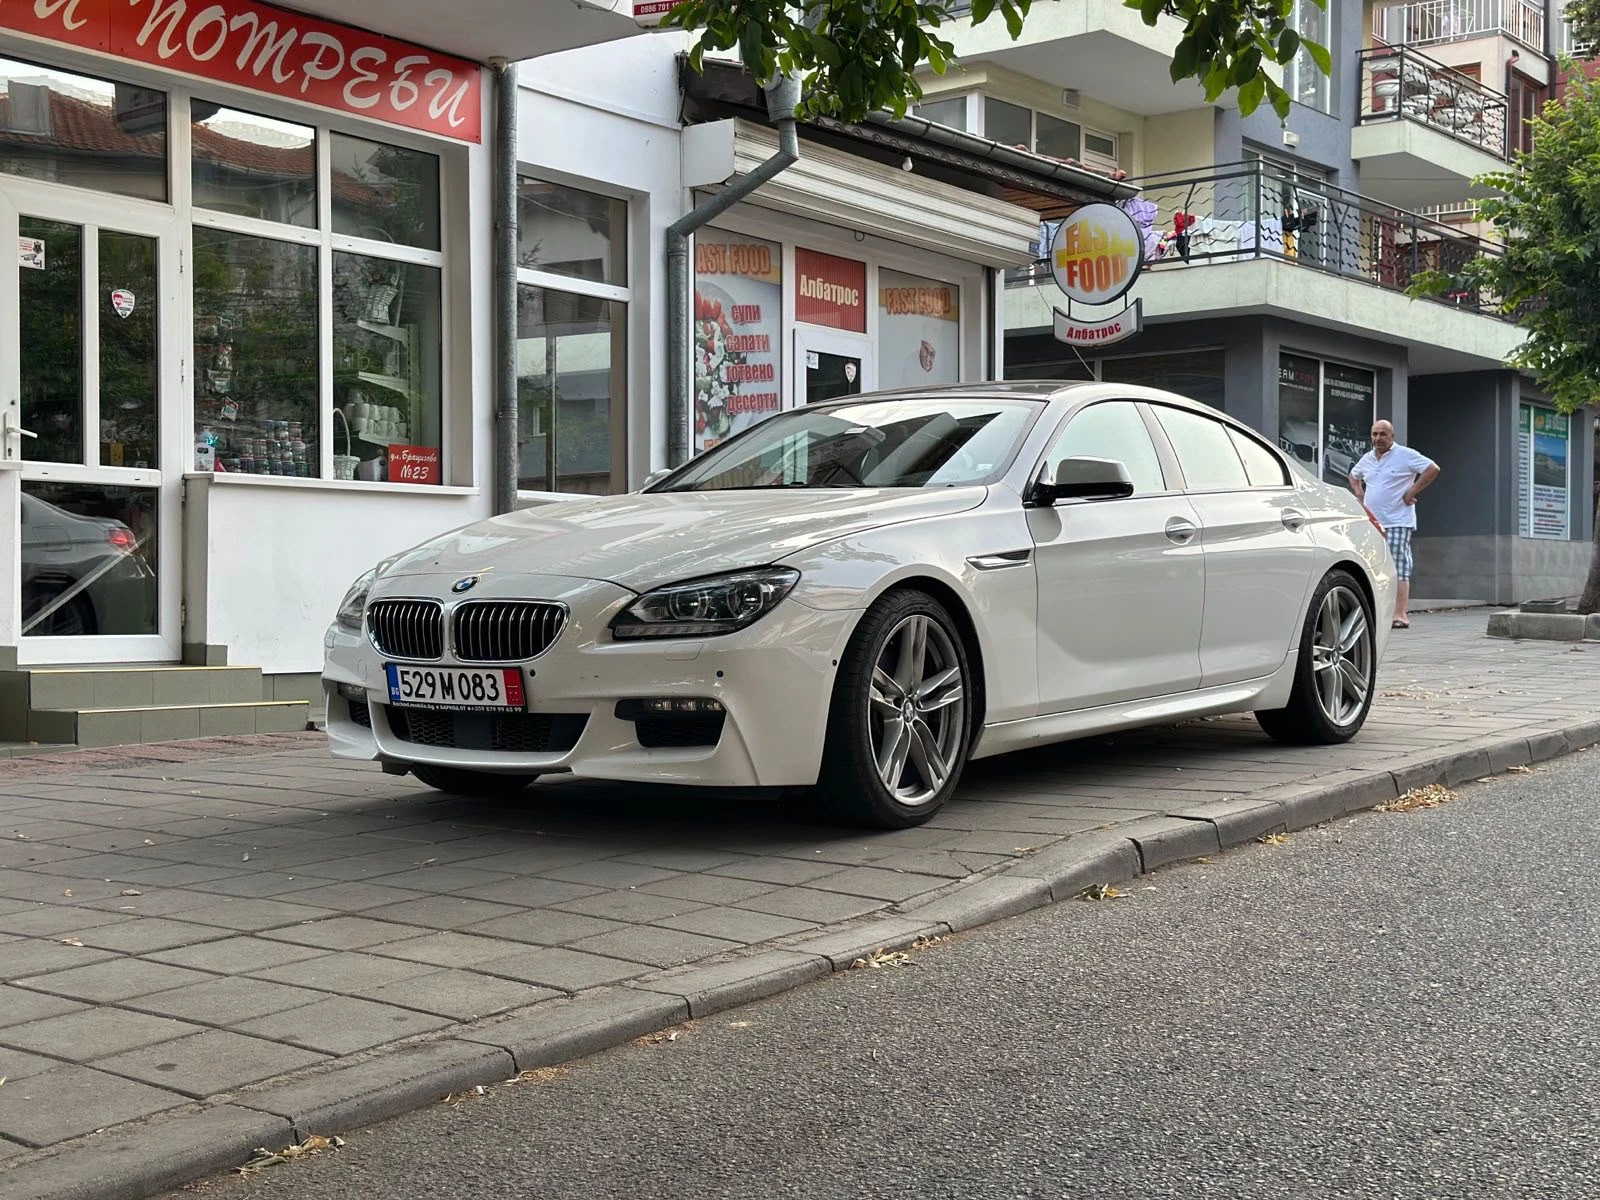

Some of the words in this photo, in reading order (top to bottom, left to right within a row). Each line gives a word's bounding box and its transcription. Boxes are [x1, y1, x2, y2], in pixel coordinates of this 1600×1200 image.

[730, 244, 771, 274] FOOD
[1067, 255, 1128, 293] FOOD
[800, 274, 859, 307] Албатрос
[885, 287, 916, 315] FAST
[918, 287, 951, 314] FOOD
[731, 304, 761, 326] супи
[725, 334, 770, 352] салати
[1067, 323, 1121, 340] Албатрос
[725, 364, 774, 382] готвено
[726, 393, 777, 416] десерти
